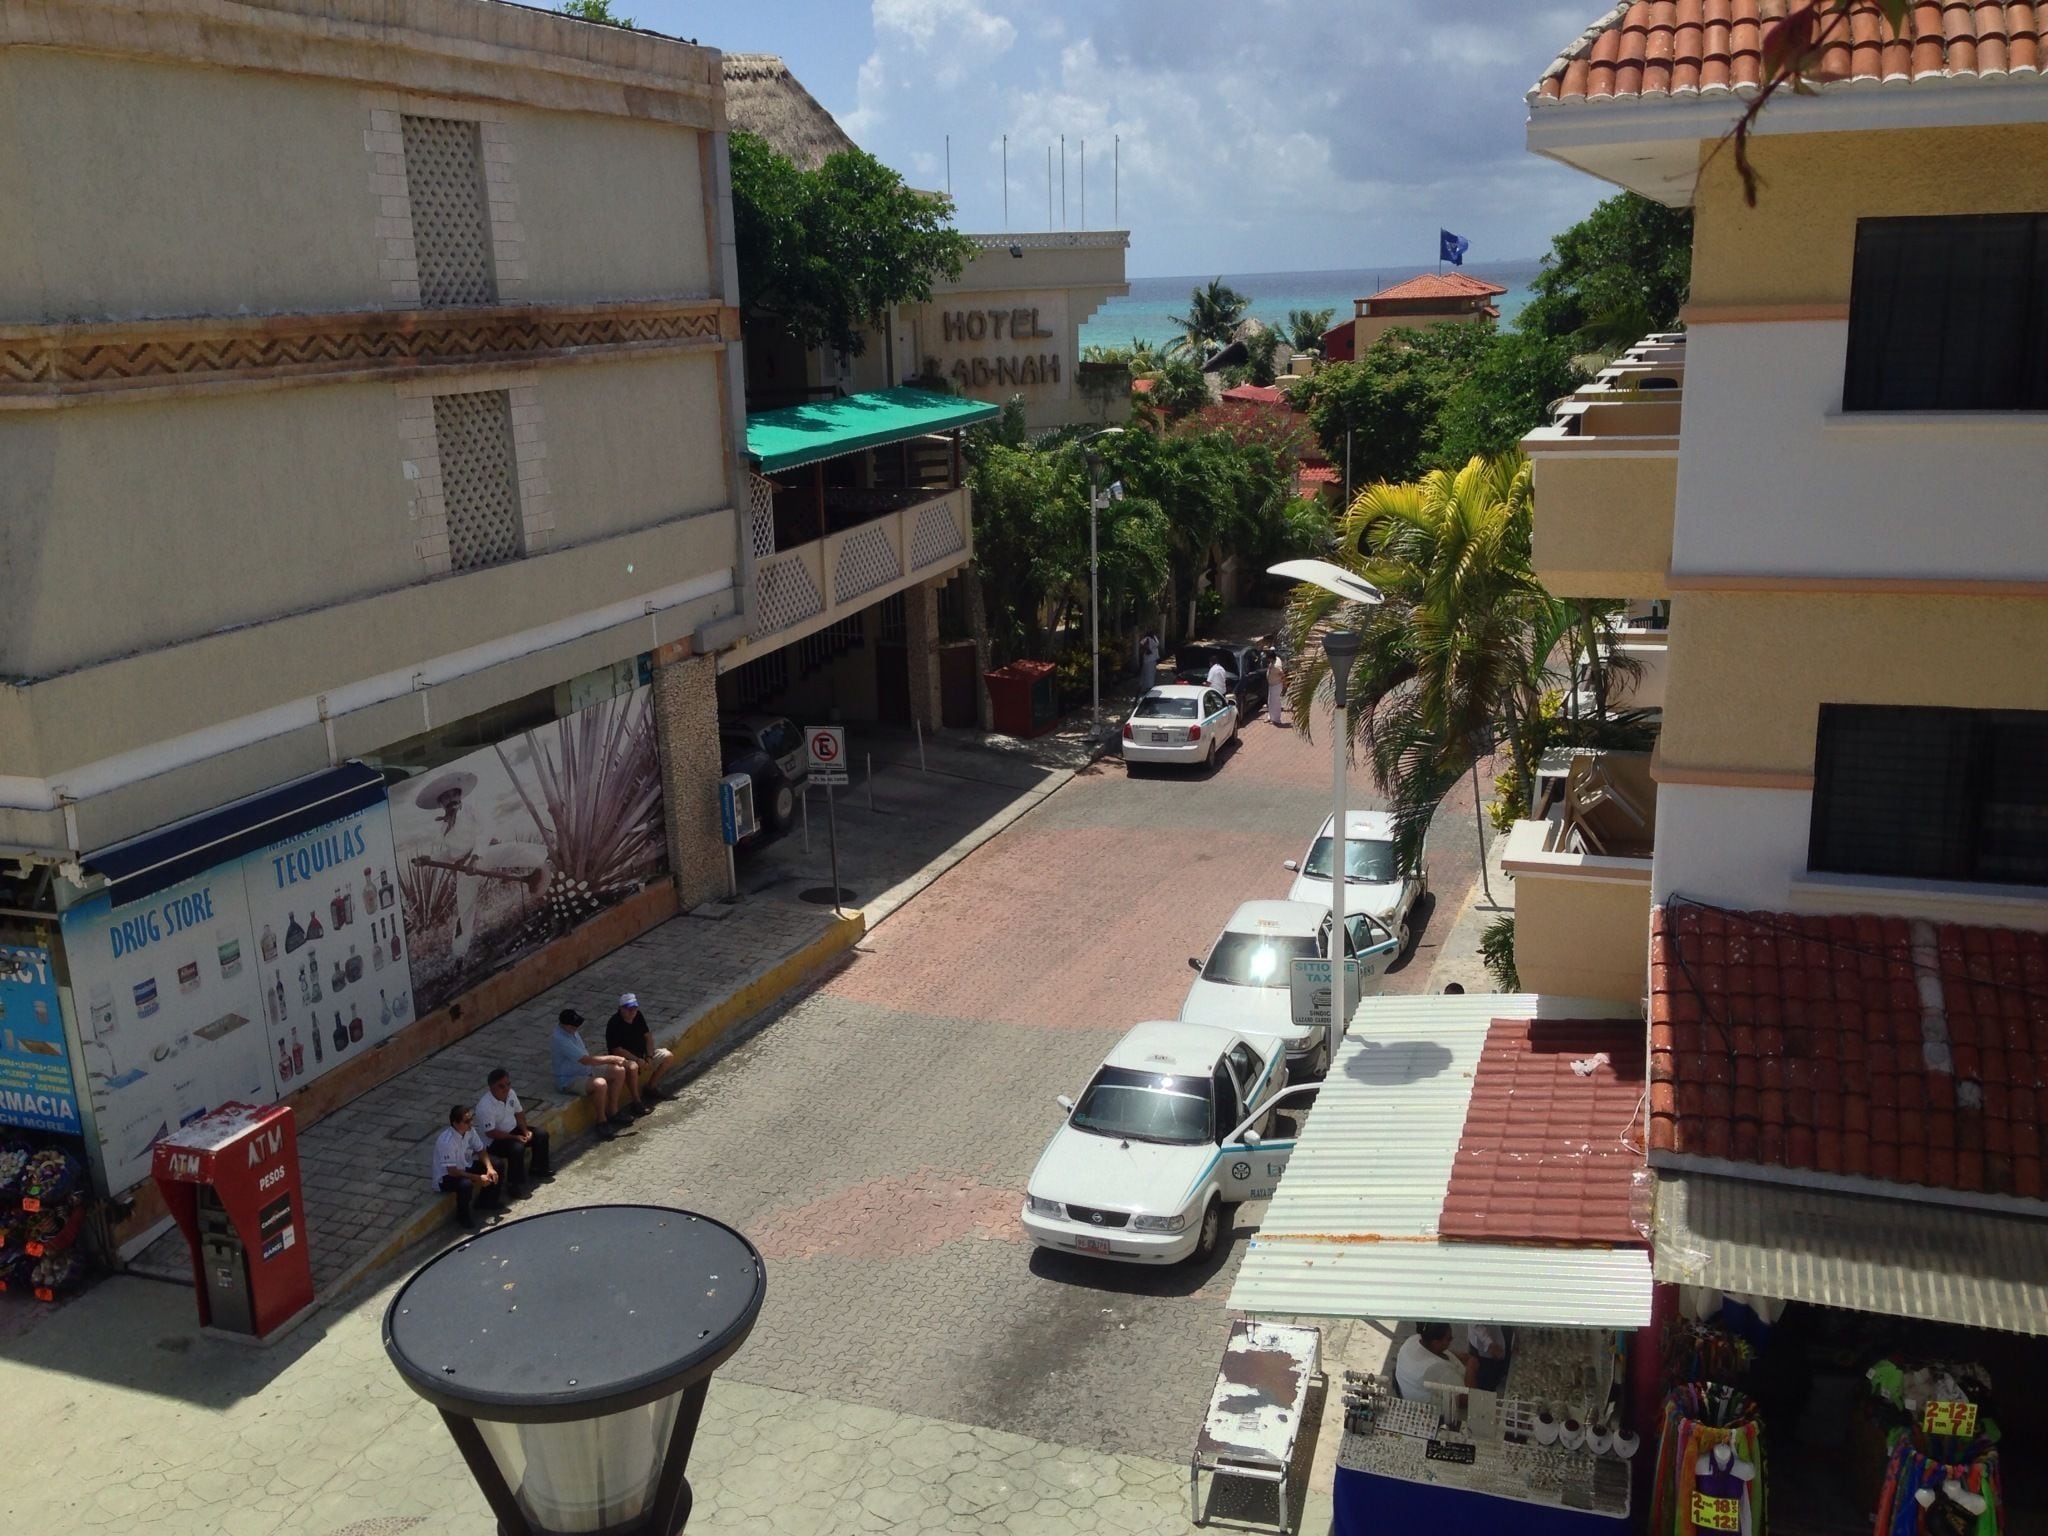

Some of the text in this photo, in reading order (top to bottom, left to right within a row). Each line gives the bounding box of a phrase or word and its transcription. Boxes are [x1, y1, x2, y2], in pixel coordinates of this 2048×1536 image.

[943, 308, 1053, 342] HOTEL
[272, 823, 366, 889] TEQUILAS
[110, 909, 161, 959] DRUG
[163, 887, 215, 937] STORE
[1295, 963, 1330, 972] SITIO
[248, 1124, 284, 1169] ATM
[169, 1152, 200, 1174] ATM
[259, 1165, 286, 1192] PESOS
[1927, 1402, 1939, 1418] 2
[1949, 1402, 1968, 1420] 12
[1926, 1418, 1934, 1434] 1
[1951, 1420, 1962, 1435] 7
[1692, 1494, 1704, 1510] 2
[1713, 1500, 1730, 1513] 18
[1693, 1510, 1700, 1523] 1
[1712, 1515, 1730, 1528] 12
